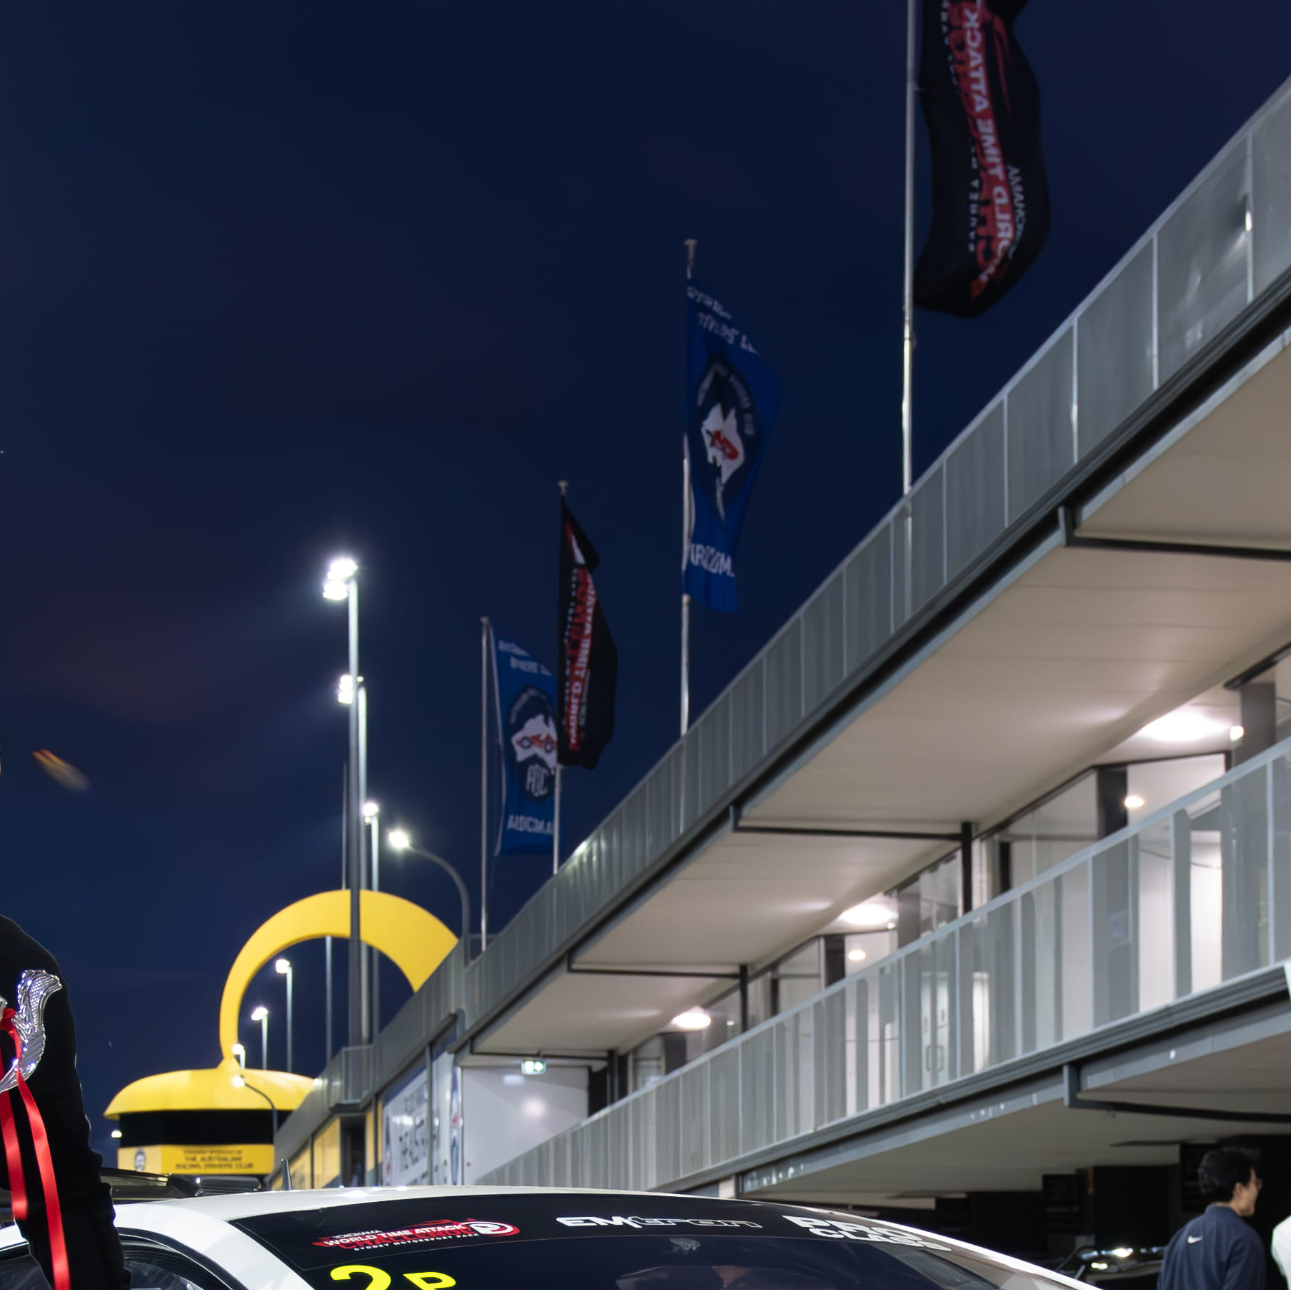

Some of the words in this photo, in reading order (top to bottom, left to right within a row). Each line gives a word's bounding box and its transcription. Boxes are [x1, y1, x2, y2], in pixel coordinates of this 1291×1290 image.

[324, 1233, 378, 1247] WORLD
[379, 1229, 412, 1239] TIME
[413, 1223, 467, 1236] ATTACK
